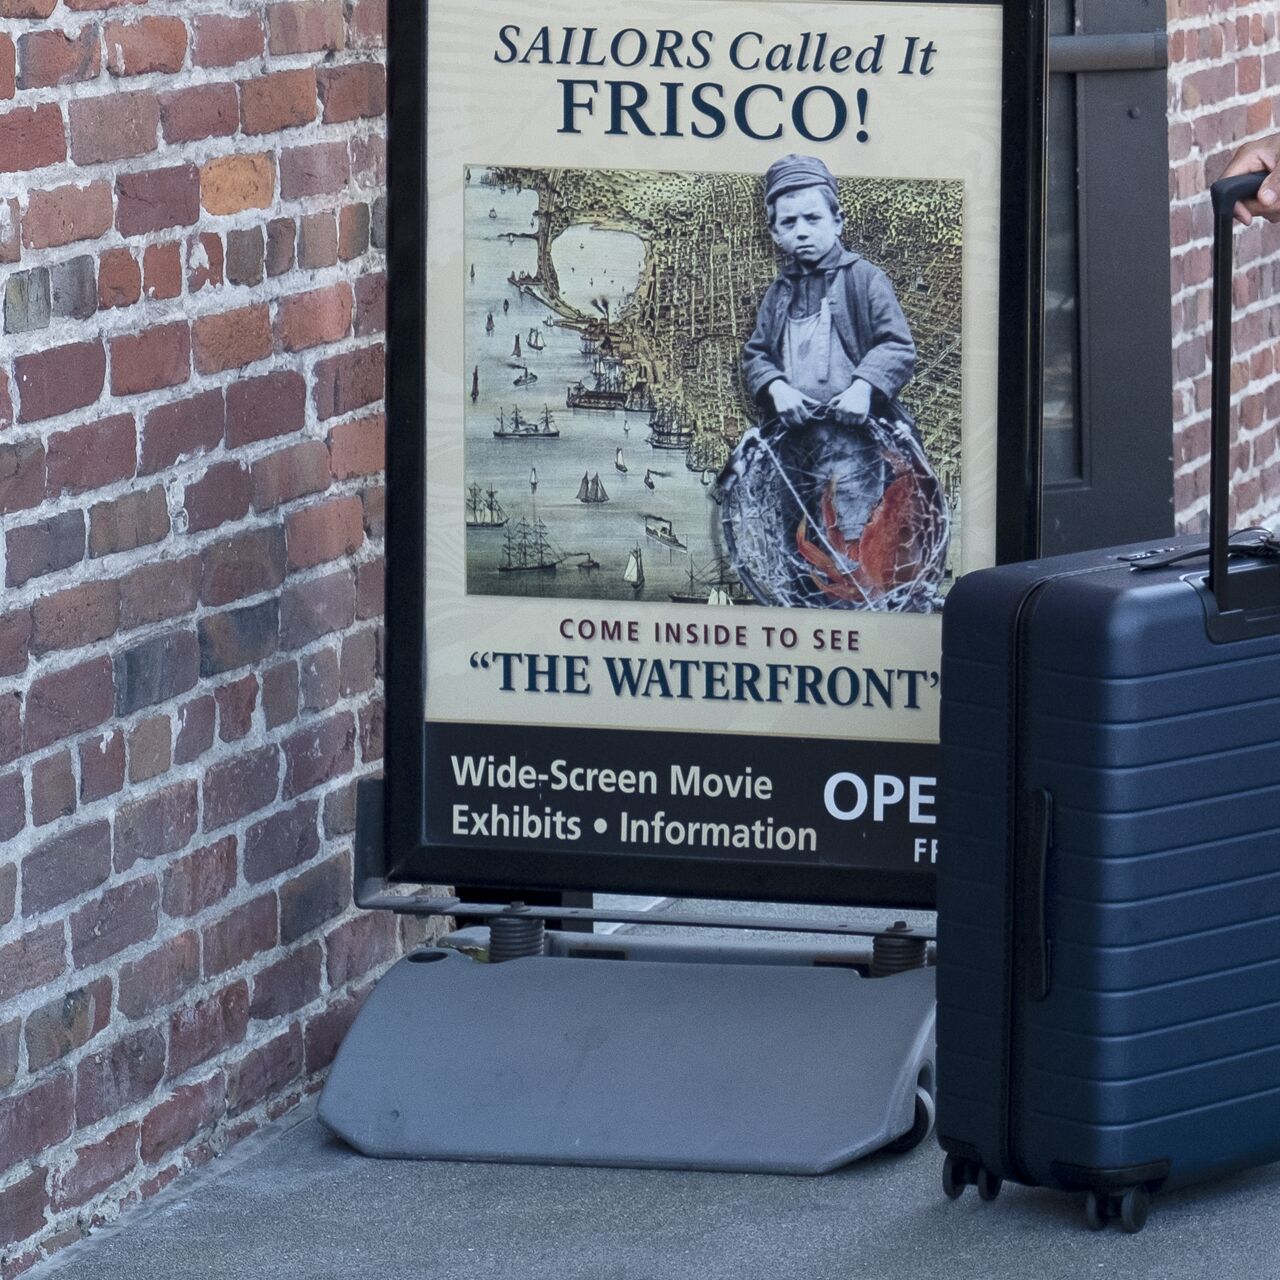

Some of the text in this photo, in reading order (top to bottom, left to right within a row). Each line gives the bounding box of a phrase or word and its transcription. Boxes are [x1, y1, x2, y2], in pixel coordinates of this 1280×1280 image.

[494, 24, 937, 76] SAILORS Called It
[556, 78, 869, 143] FRISCO!
[559, 618, 860, 651] COME INSIDE TO SEE
[451, 755, 773, 799] Wide-Screen Movie
[451, 804, 818, 852] Exhibits Information
